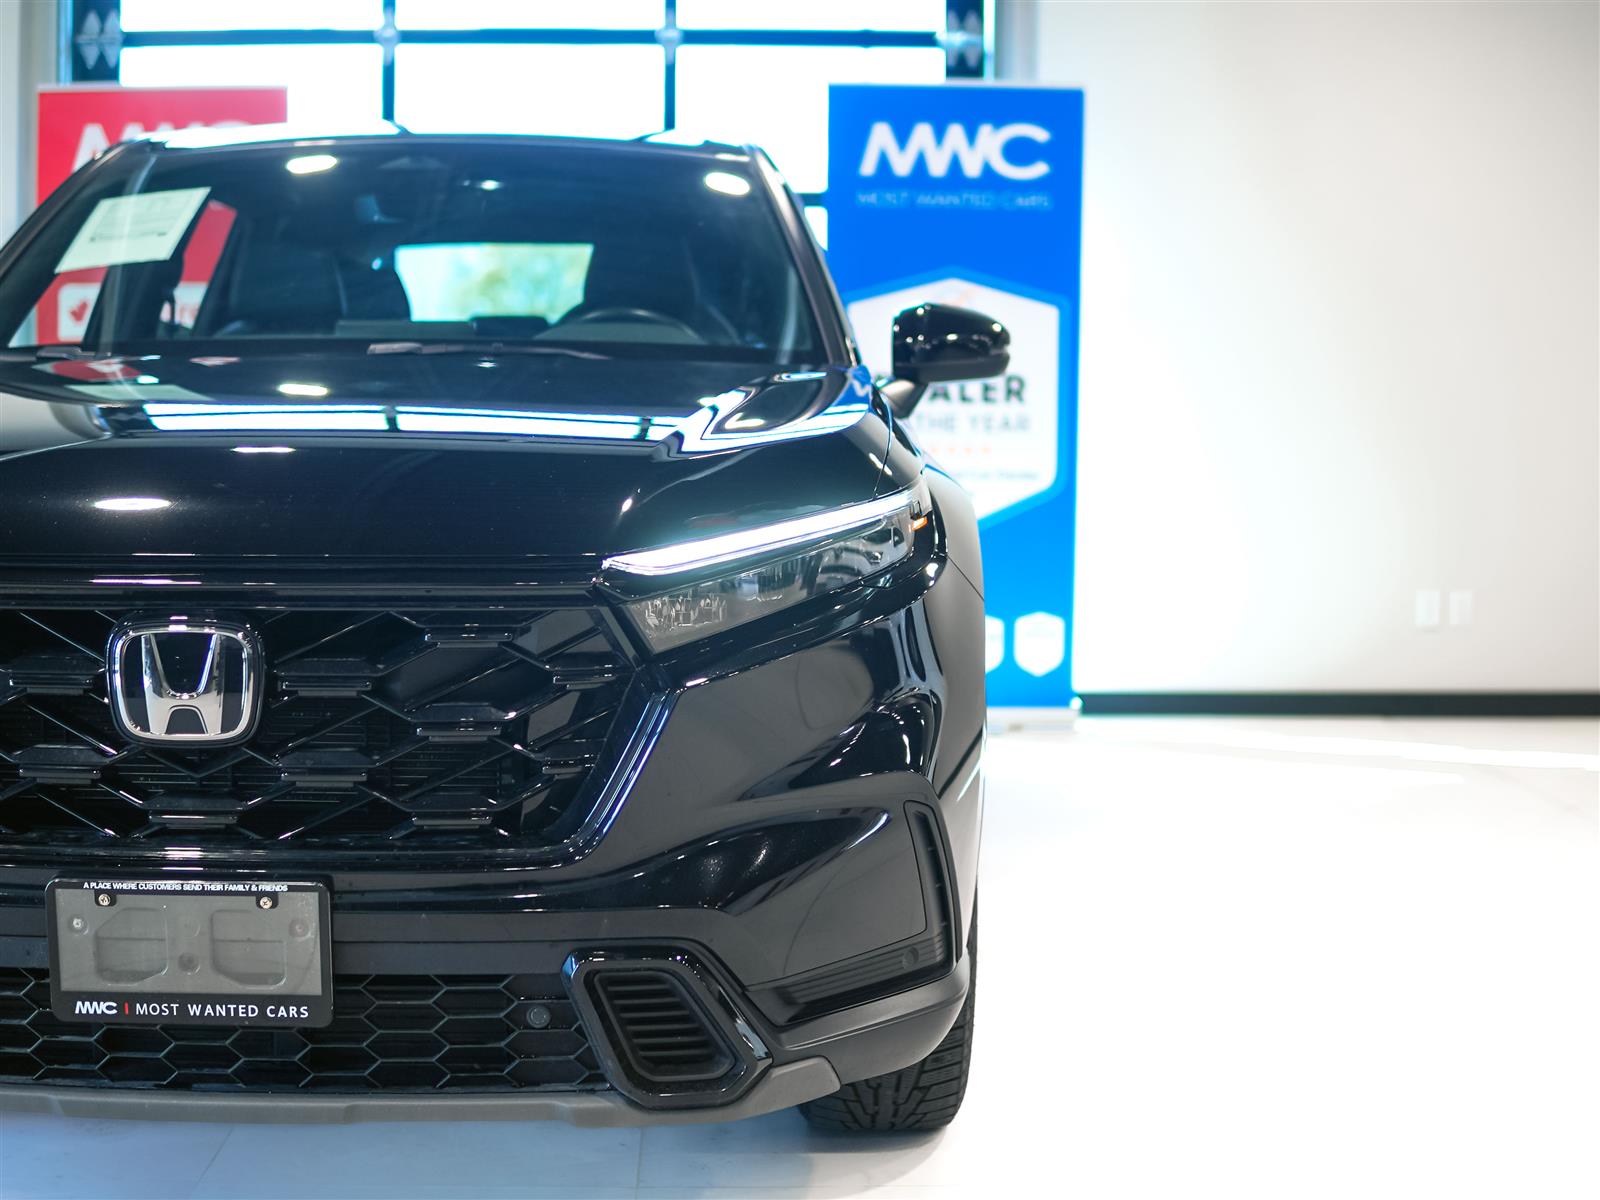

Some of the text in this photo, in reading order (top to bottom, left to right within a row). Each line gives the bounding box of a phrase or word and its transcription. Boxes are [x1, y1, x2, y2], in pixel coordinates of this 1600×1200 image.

[859, 121, 1051, 180] MWC
[928, 374, 1027, 404] ALER
[969, 412, 1031, 434] YEAR
[112, 882, 137, 890] WHERE
[183, 883, 203, 891] SEND
[203, 884, 224, 892] THEIR
[224, 884, 250, 892] FAMILY
[258, 884, 288, 892] FRIENDS
[75, 1000, 309, 1019] MWC MOST WANTED CARS
